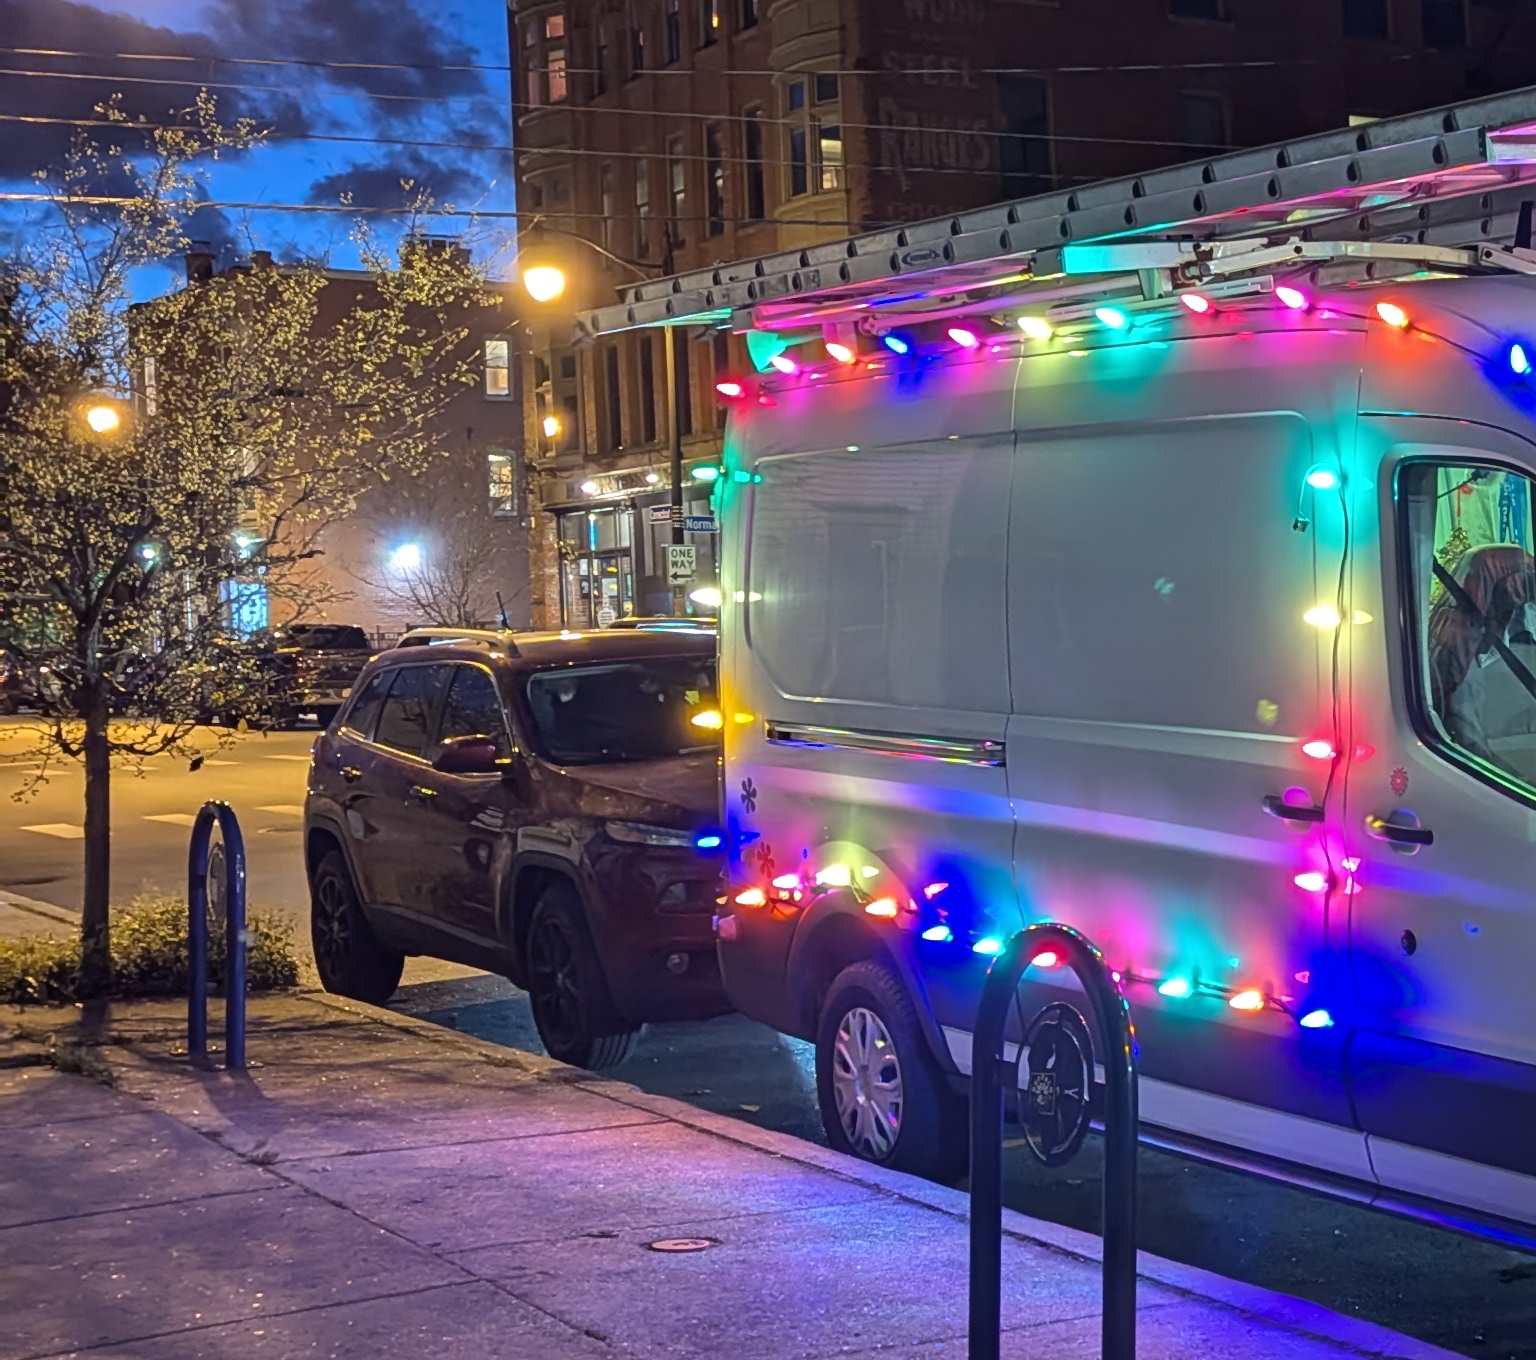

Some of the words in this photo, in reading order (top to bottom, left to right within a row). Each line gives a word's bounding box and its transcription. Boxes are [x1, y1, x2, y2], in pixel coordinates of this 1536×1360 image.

[883, 50, 980, 90] STEEL
[671, 549, 693, 559] ONE
[671, 559, 694, 569] WAY
